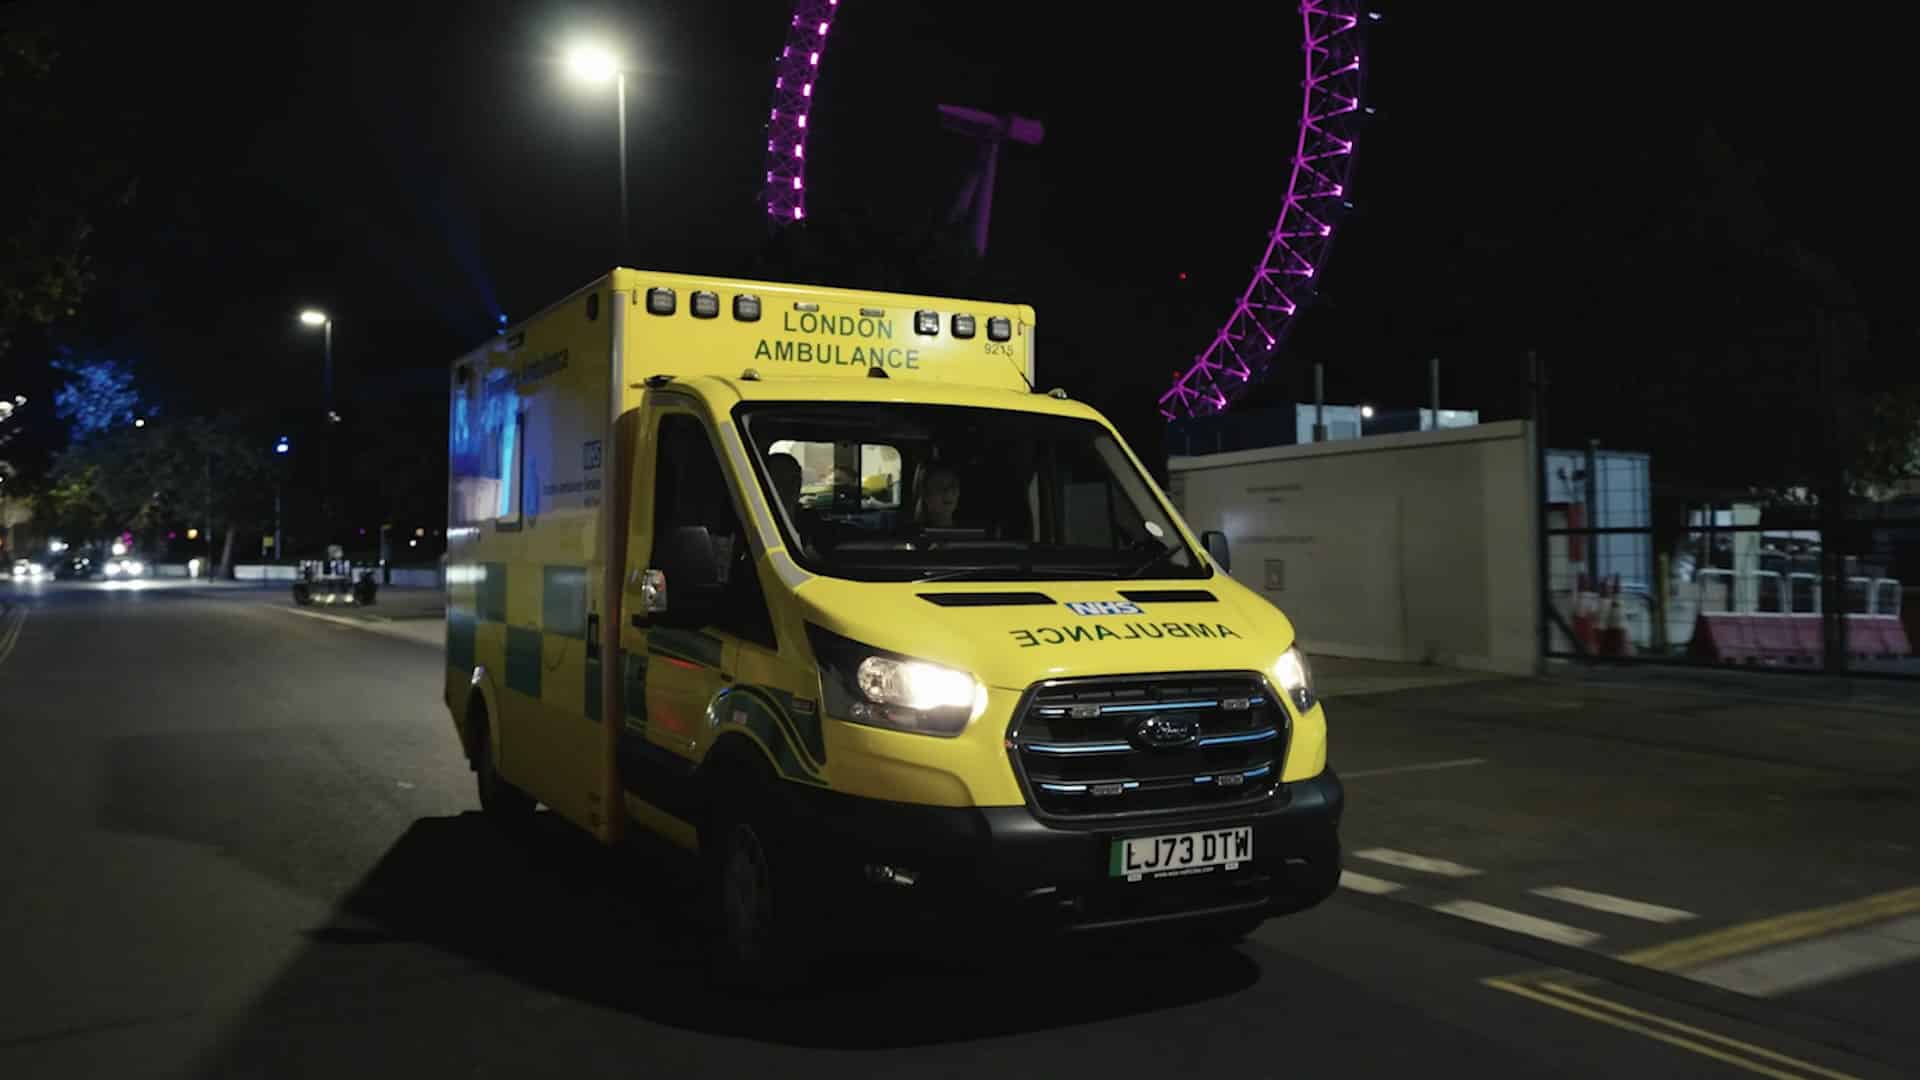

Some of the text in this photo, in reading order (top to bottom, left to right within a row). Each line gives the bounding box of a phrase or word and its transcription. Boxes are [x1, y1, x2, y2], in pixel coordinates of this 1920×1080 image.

[784, 311, 893, 339] LONDON
[754, 339, 920, 370] AMBULANCE
[984, 342, 1015, 358] 9215
[1072, 601, 1141, 615] NHS
[1127, 829, 1249, 870] LJ73 DTW
